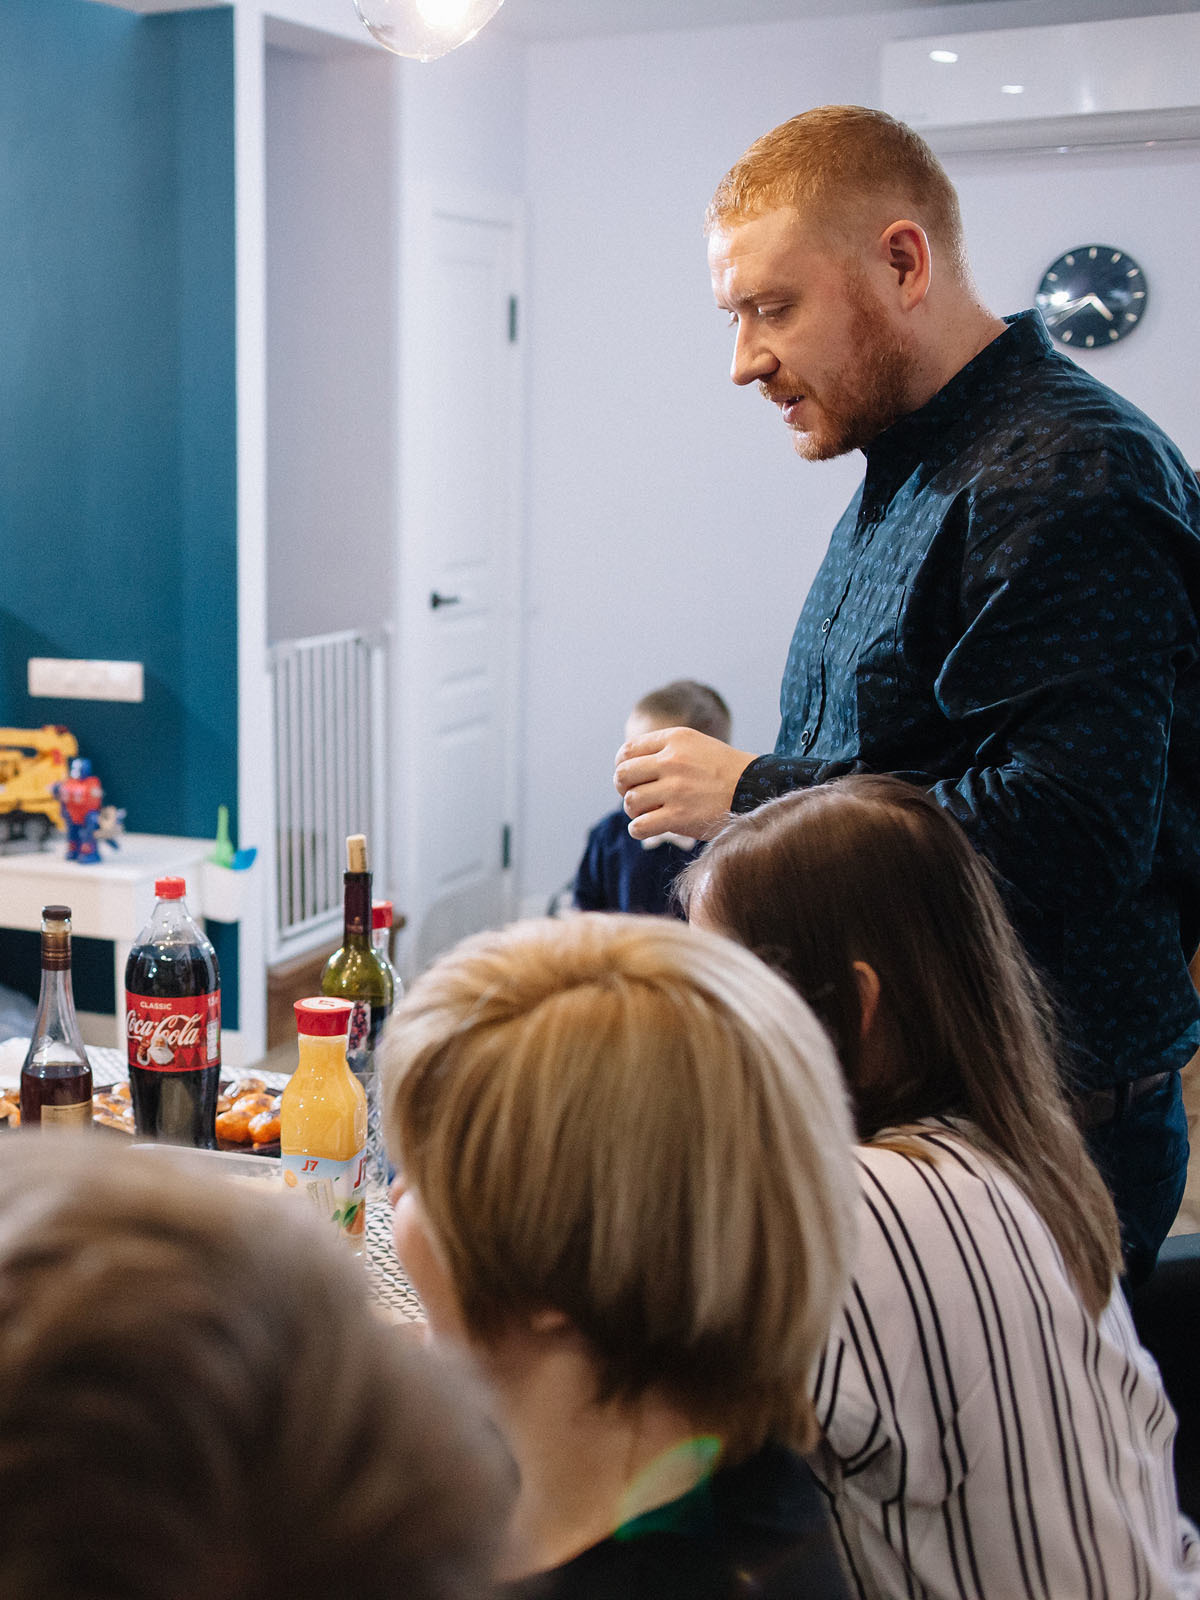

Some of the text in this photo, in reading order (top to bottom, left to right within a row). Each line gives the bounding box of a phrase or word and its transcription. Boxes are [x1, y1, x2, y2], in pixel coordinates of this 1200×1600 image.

[140, 1001, 173, 1011] CLASSIC
[127, 1009, 204, 1046] Coca-Cola
[301, 1160, 319, 1172] J7
